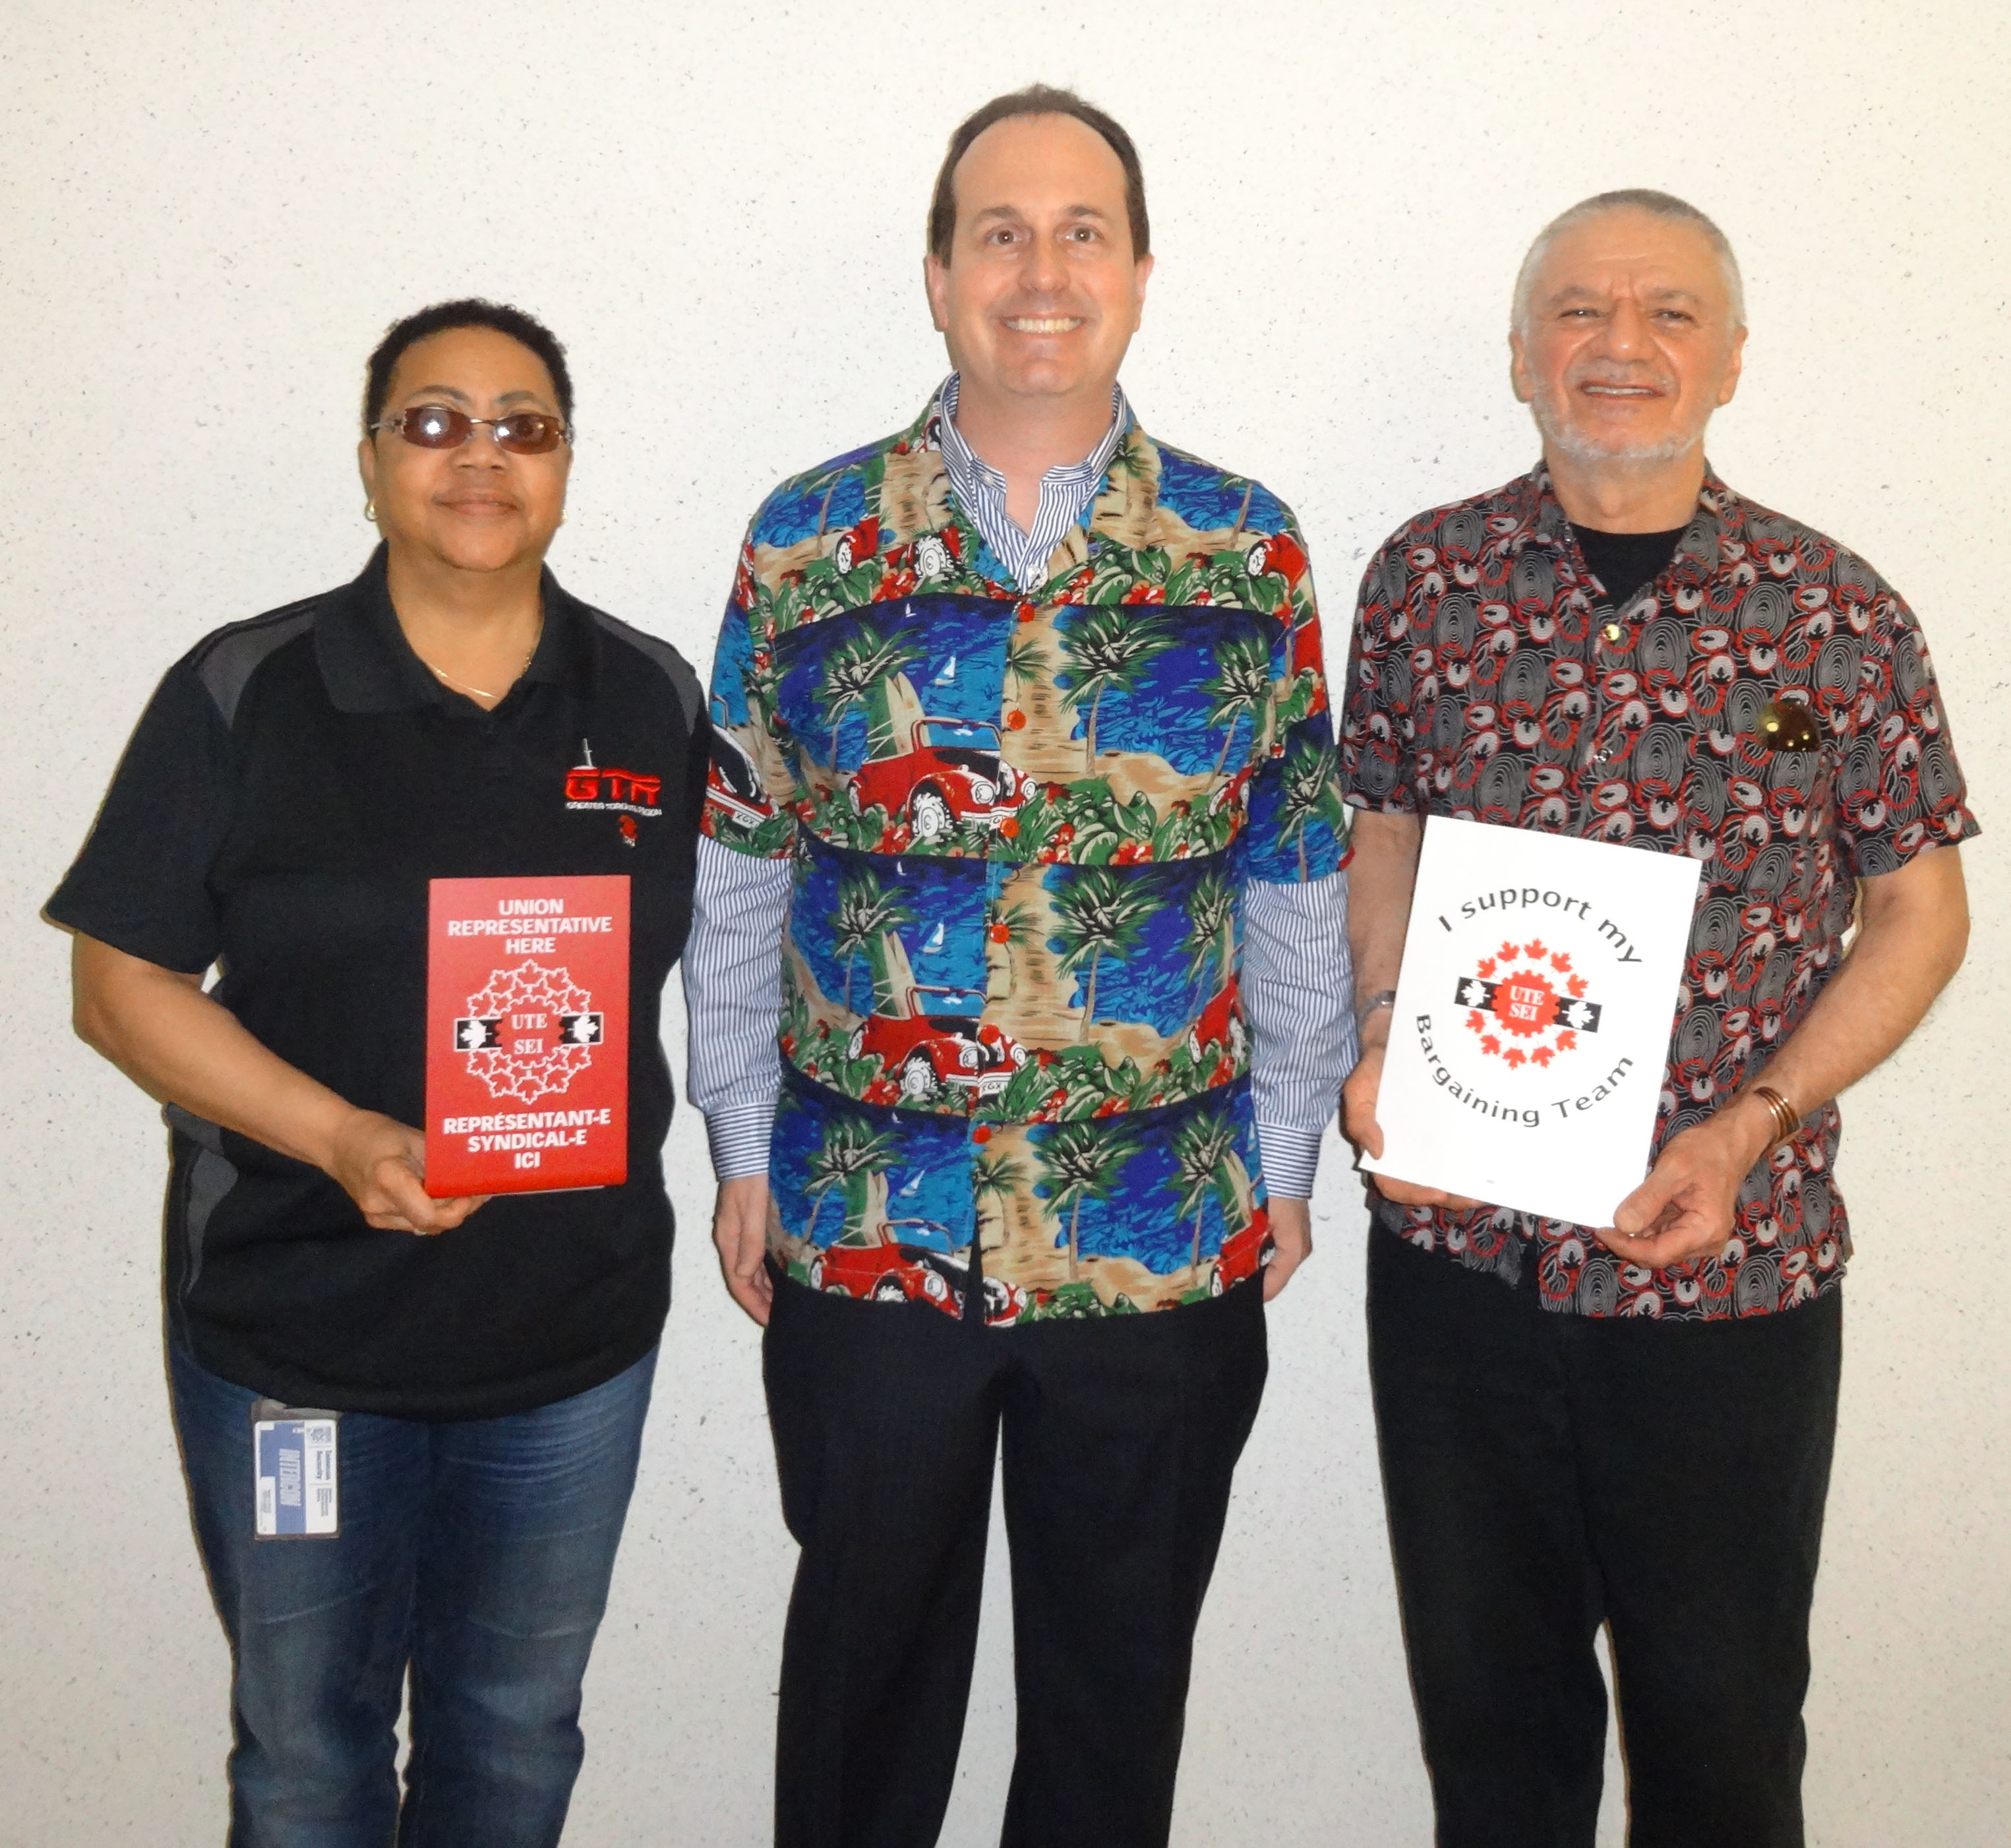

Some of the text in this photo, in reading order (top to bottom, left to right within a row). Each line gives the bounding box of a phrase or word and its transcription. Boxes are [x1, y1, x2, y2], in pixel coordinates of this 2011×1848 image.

[565, 769, 661, 806] GTR
[498, 899, 564, 916] UNION
[447, 916, 613, 937] REPRESENTATIVE
[1438, 887, 1643, 963] I support my
[505, 938, 556, 955] HERE
[1510, 985, 1545, 1005] UTE
[1509, 1001, 1539, 1021] SEI
[511, 1013, 547, 1030] UTE
[514, 1038, 543, 1056] SEI
[1416, 1014, 1634, 1127] Bargaining Team
[443, 1108, 611, 1134] REPRÉSENTANT-E
[467, 1129, 587, 1152] SYNDICAL-E
[515, 1151, 541, 1169] ICI
